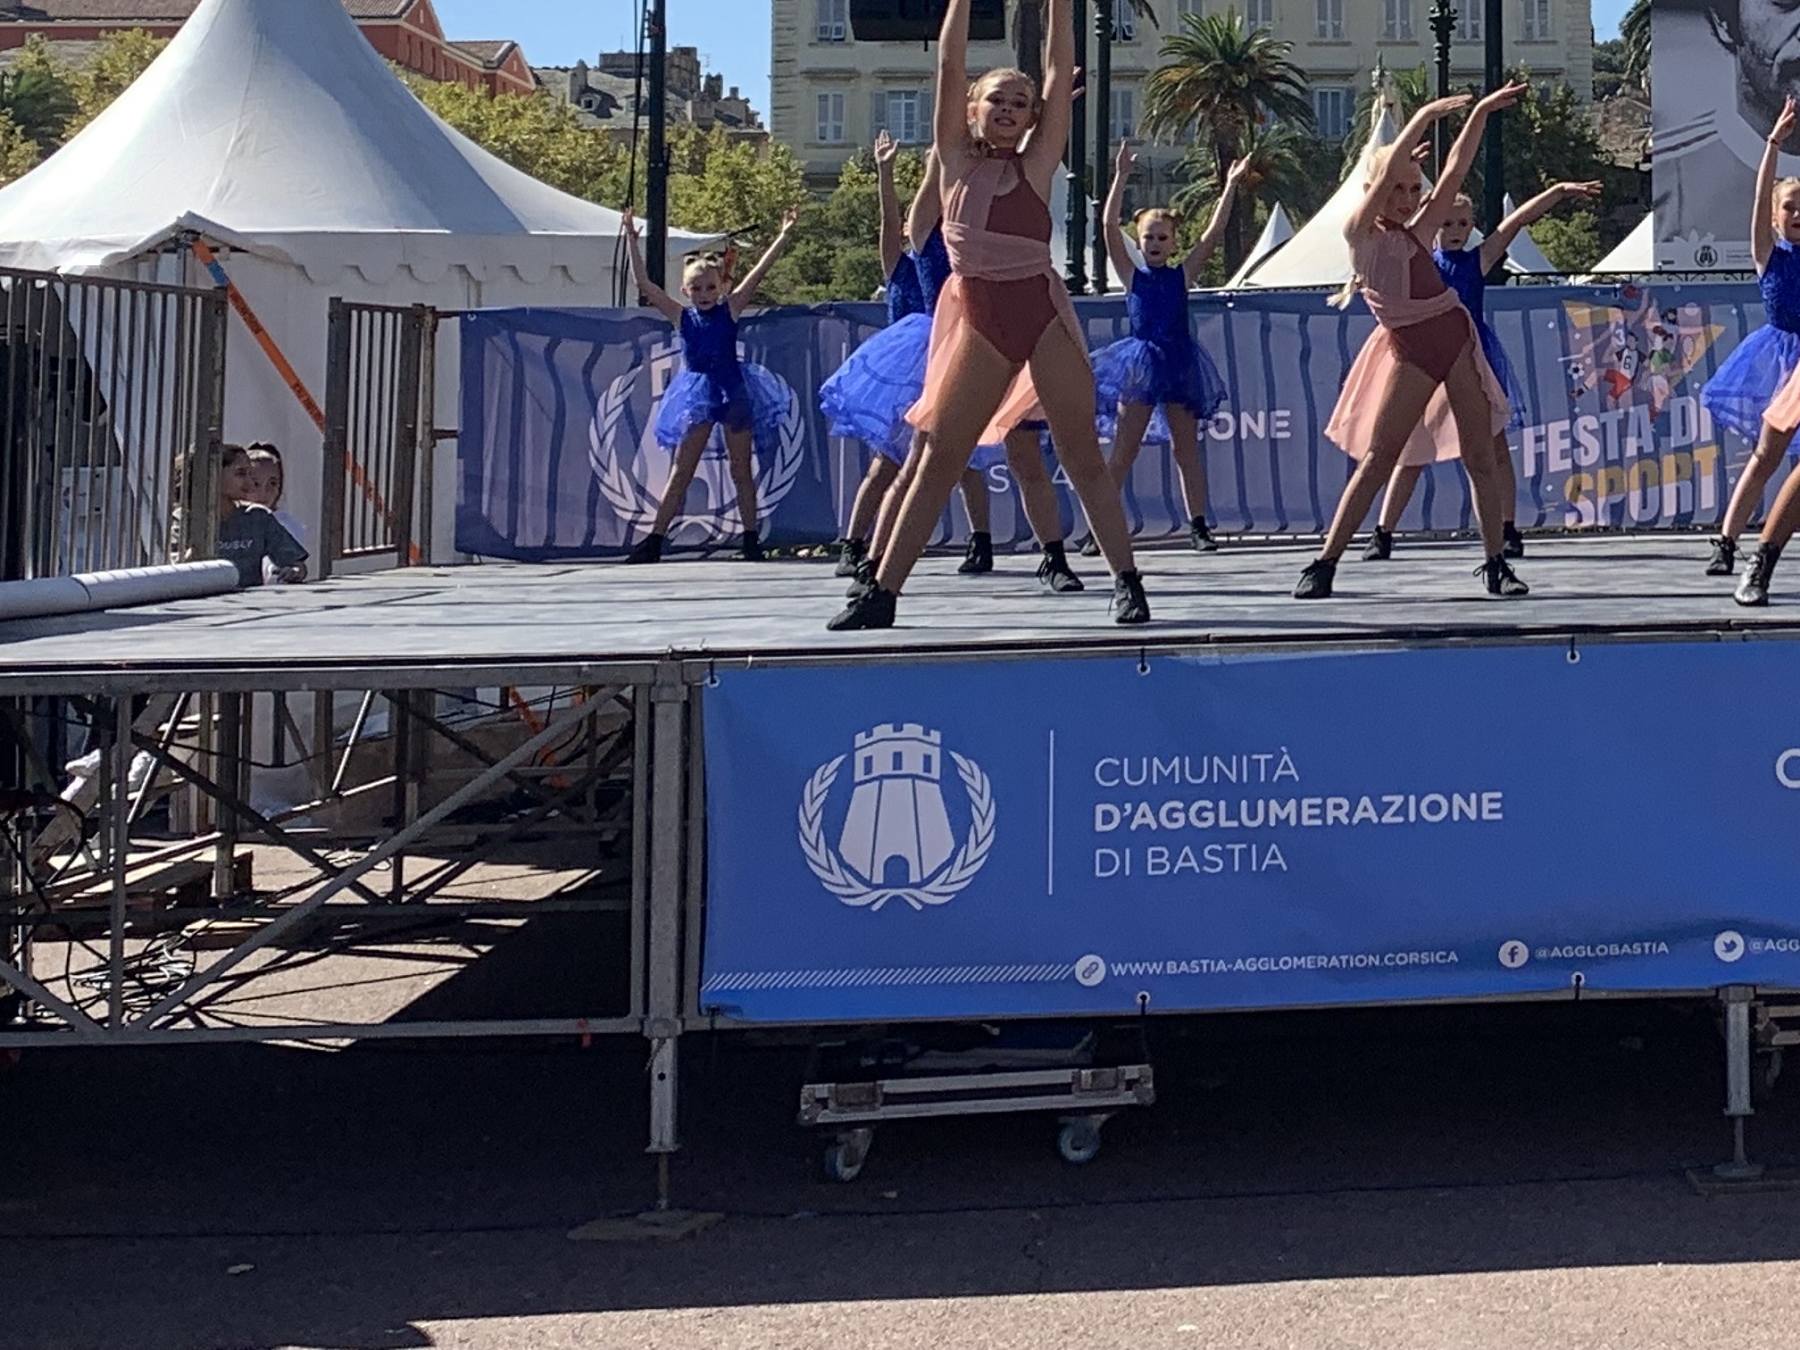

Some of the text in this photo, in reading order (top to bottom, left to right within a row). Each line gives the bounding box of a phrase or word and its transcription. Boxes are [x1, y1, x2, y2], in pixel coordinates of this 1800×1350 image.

[1522, 396, 1713, 478] FESTA DI
[1563, 444, 1721, 528] SPORT
[1094, 746, 1300, 787] CUMUNITÀ
[1094, 791, 1504, 832] D’AGGLUMERAZIONE
[1094, 843, 1289, 878] DI BASTIA
[1110, 950, 1459, 977] WWW.BASTIA-AGGLOMERATION.CORSICA
[1534, 941, 1670, 960] @AGGLOBASTIA
